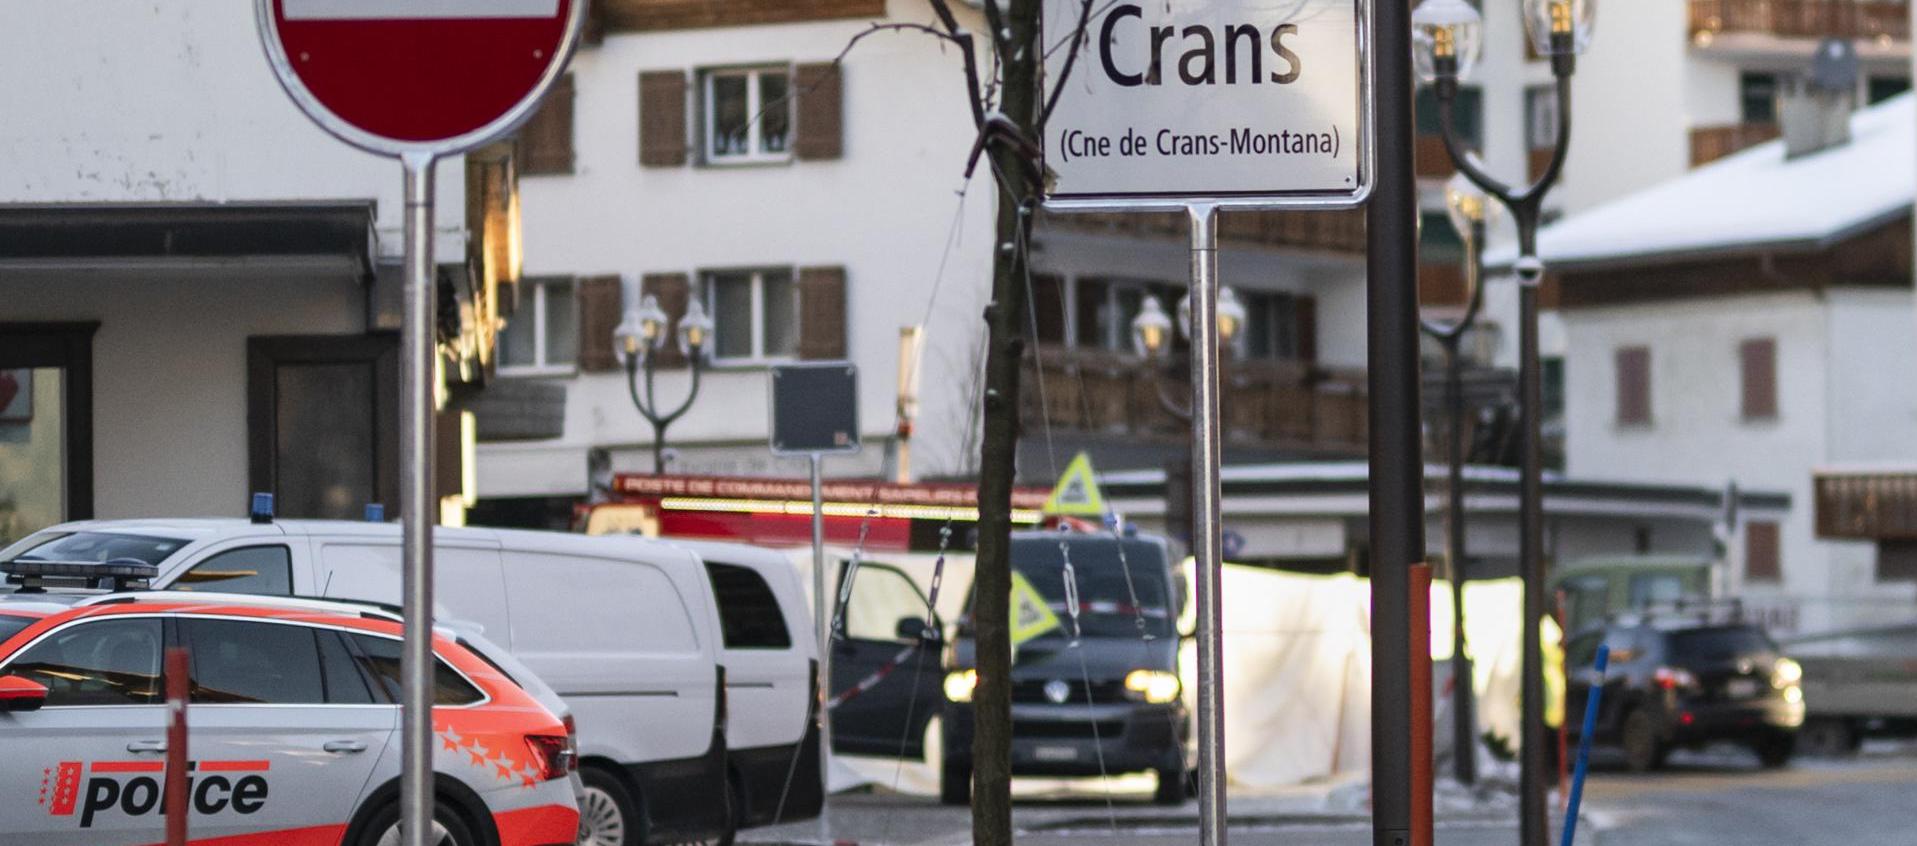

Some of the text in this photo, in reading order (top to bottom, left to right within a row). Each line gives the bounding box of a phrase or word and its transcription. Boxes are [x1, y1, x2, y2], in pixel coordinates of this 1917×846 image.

[1099, 4, 1302, 87] Crans
[1060, 125, 1340, 162] (Cne de Crans-Montana)
[716, 481, 874, 500] COMMANDMENT
